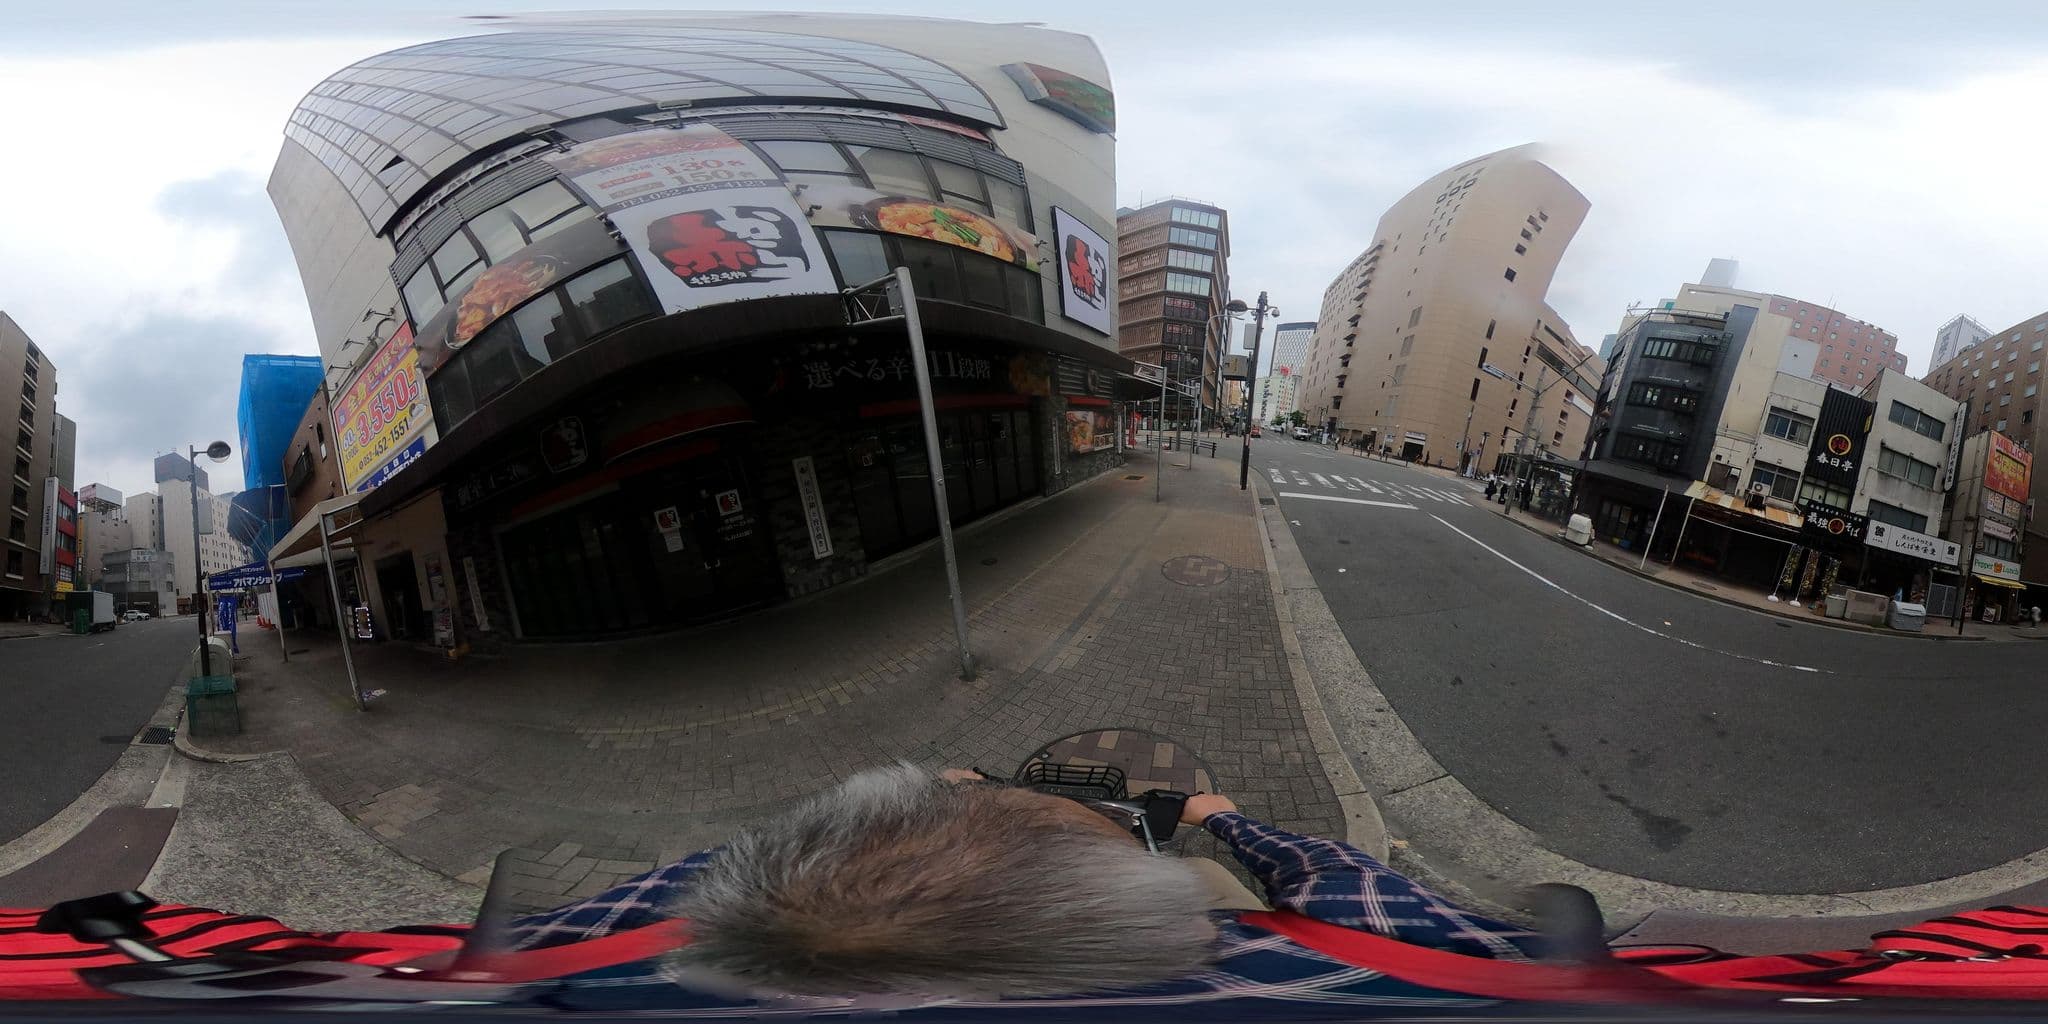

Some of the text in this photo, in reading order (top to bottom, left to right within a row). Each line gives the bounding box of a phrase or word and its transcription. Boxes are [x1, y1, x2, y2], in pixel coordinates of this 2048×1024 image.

[802, 350, 992, 390] 選べる辛11段階
[1816, 453, 1853, 472] 春日亭
[233, 574, 283, 588] アパマンショプ
